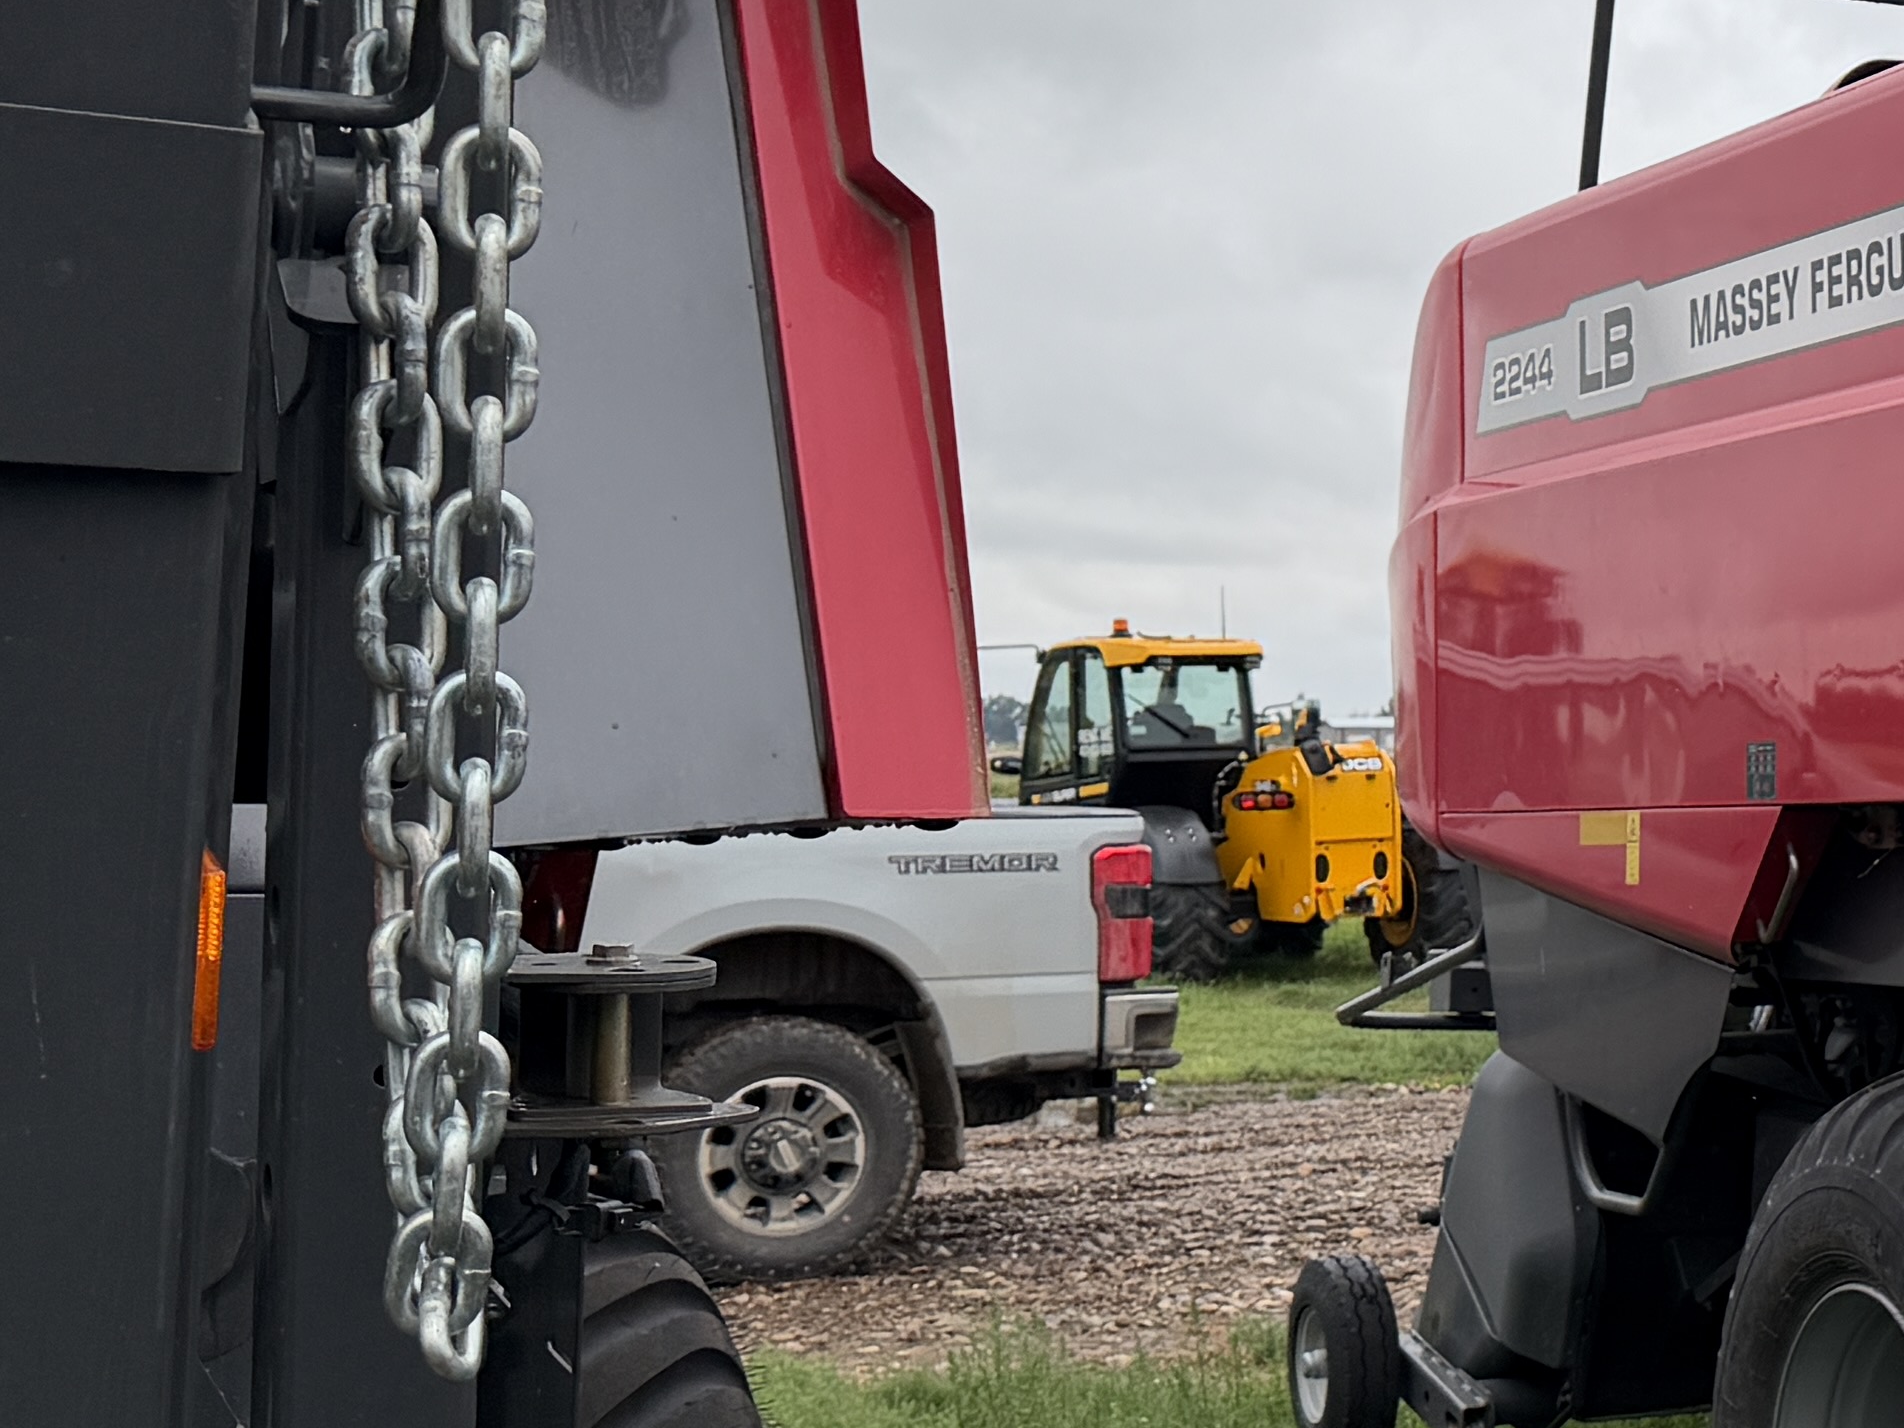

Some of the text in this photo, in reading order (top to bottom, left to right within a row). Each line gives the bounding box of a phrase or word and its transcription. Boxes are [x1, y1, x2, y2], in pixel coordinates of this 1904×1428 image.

[1491, 346, 1555, 403] 2244
[1579, 305, 1635, 396] LB
[1688, 265, 1801, 350] MASSEY
[888, 852, 1061, 875] TREMOR
